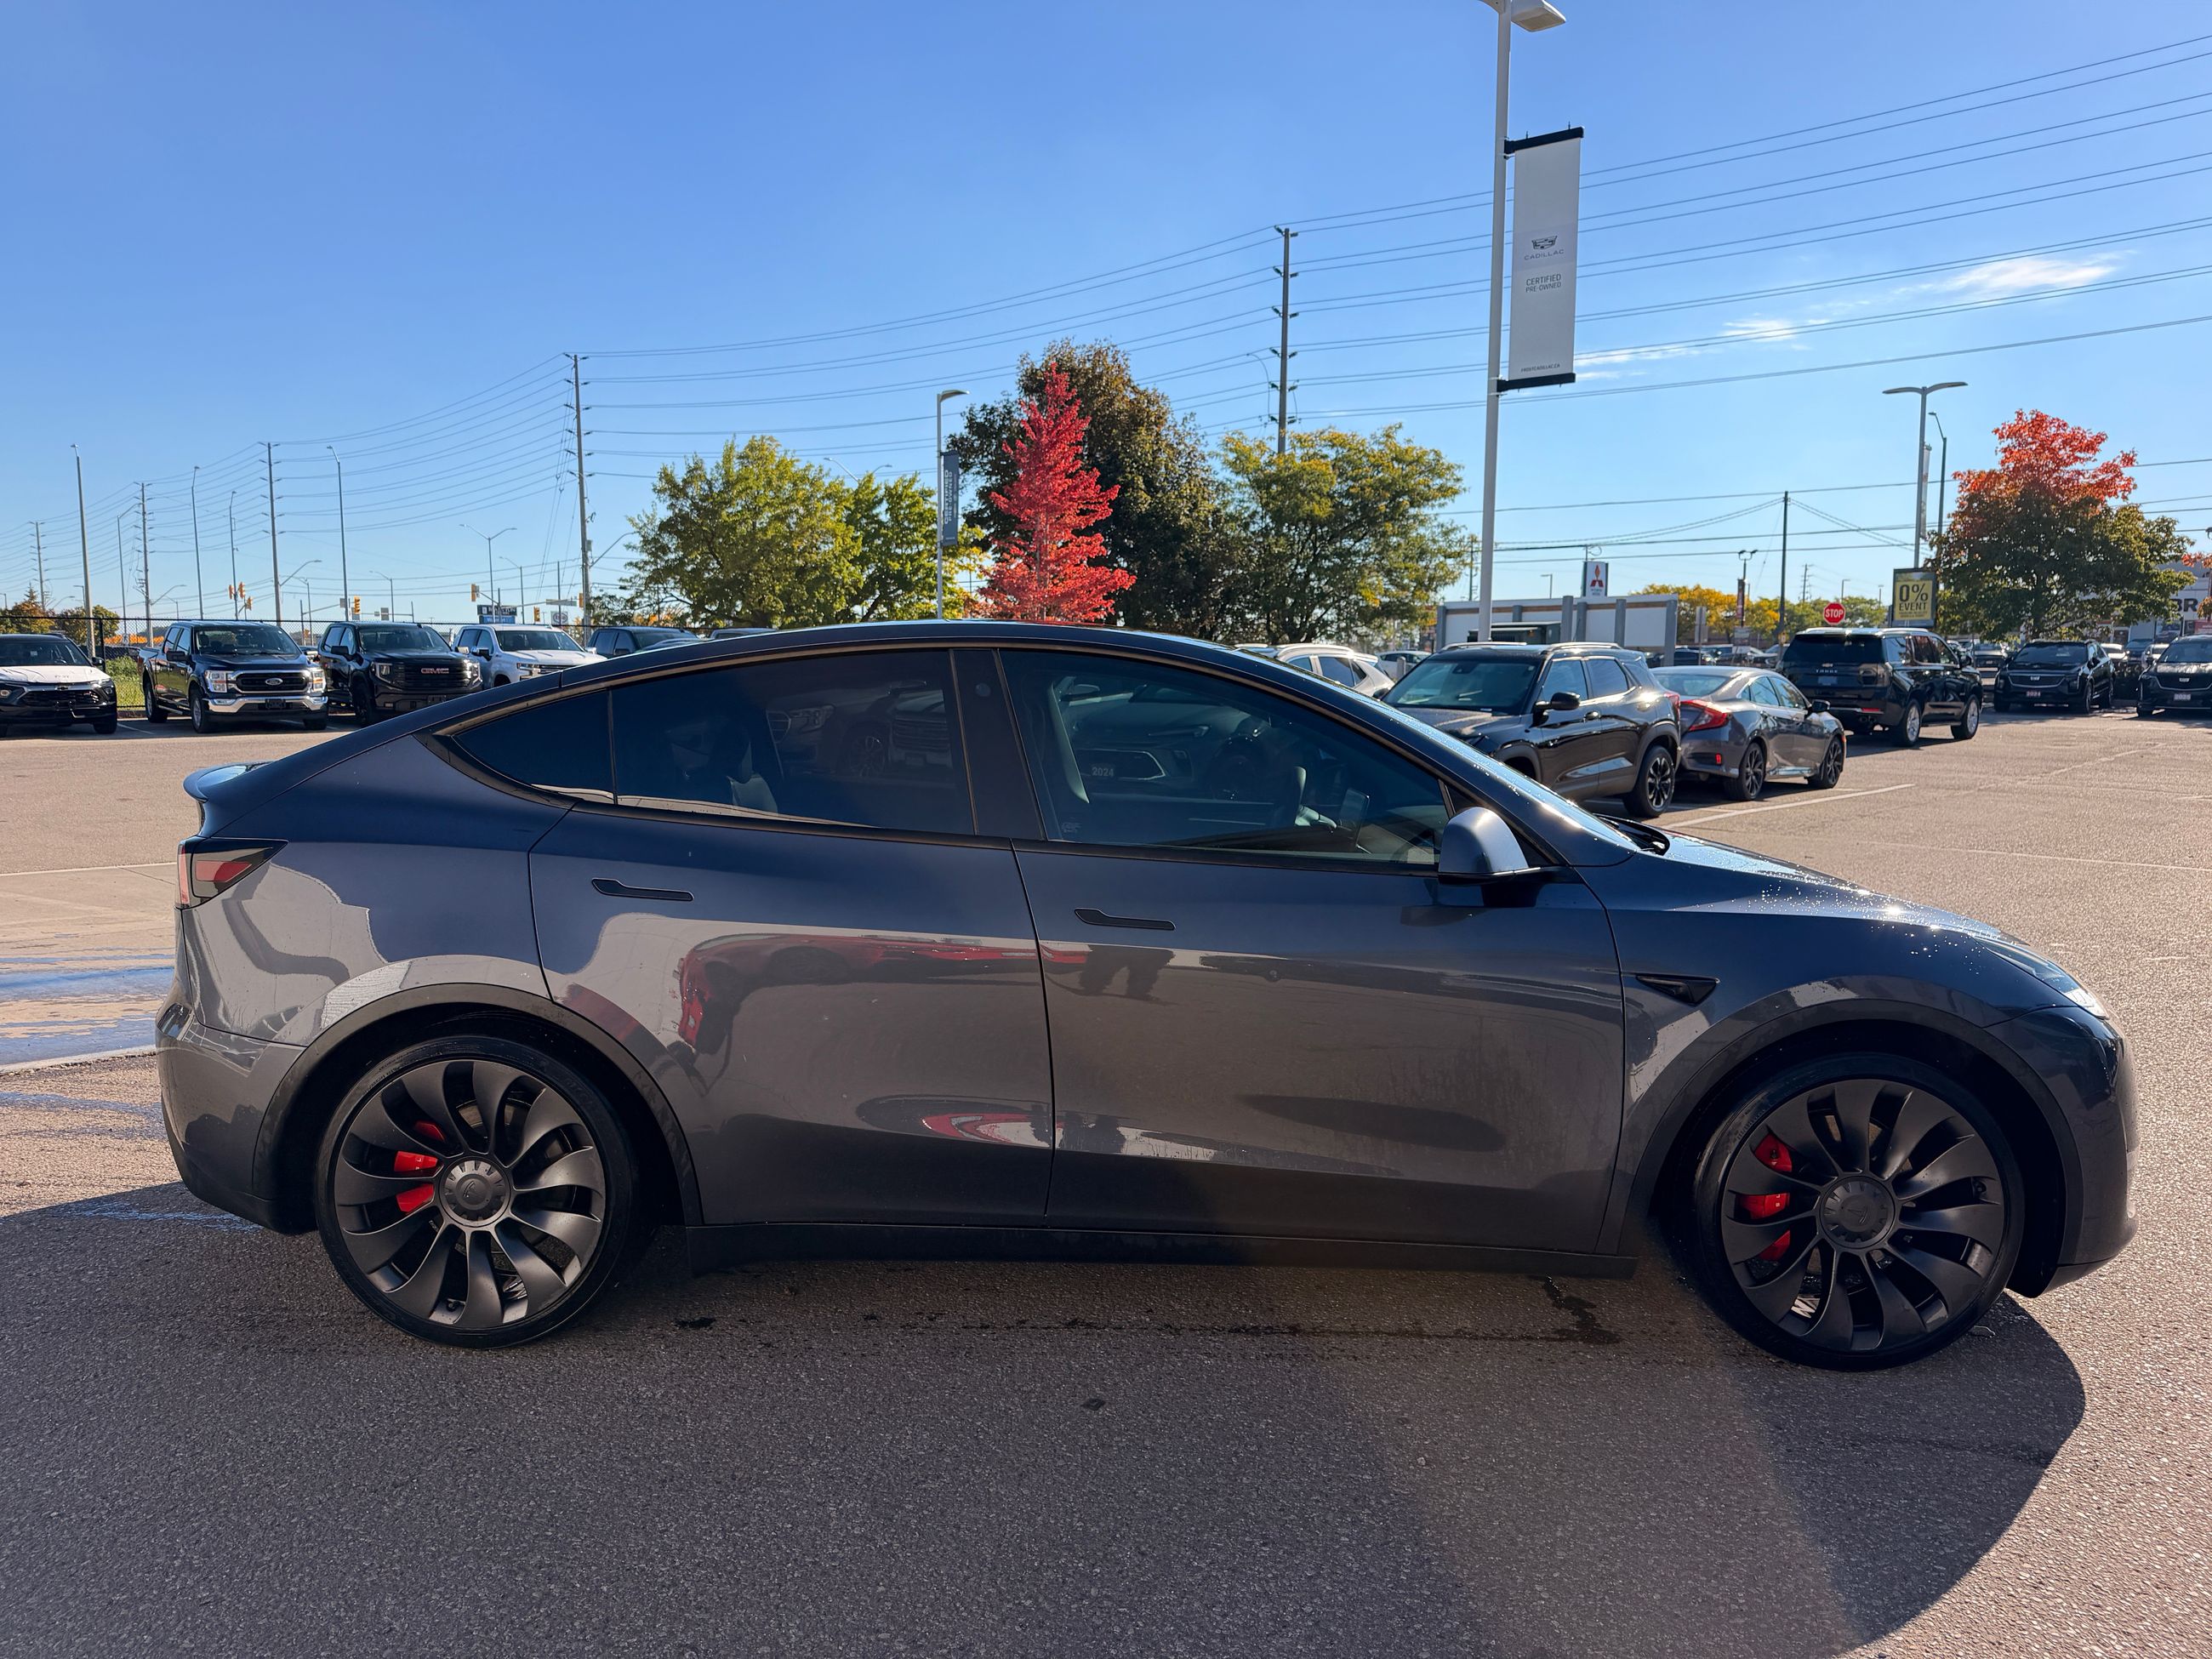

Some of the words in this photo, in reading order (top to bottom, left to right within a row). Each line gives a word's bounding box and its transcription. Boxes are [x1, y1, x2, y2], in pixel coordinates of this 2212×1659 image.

[1524, 248, 1565, 260] CADILLAC
[1525, 273, 1562, 287] CERTIFIED
[1525, 281, 1562, 294] PRE-OWNED
[1899, 583, 1929, 602] 0%
[1899, 602, 1926, 611] EVENT
[1825, 608, 1844, 619] STOP
[1092, 767, 1115, 777] 2024
